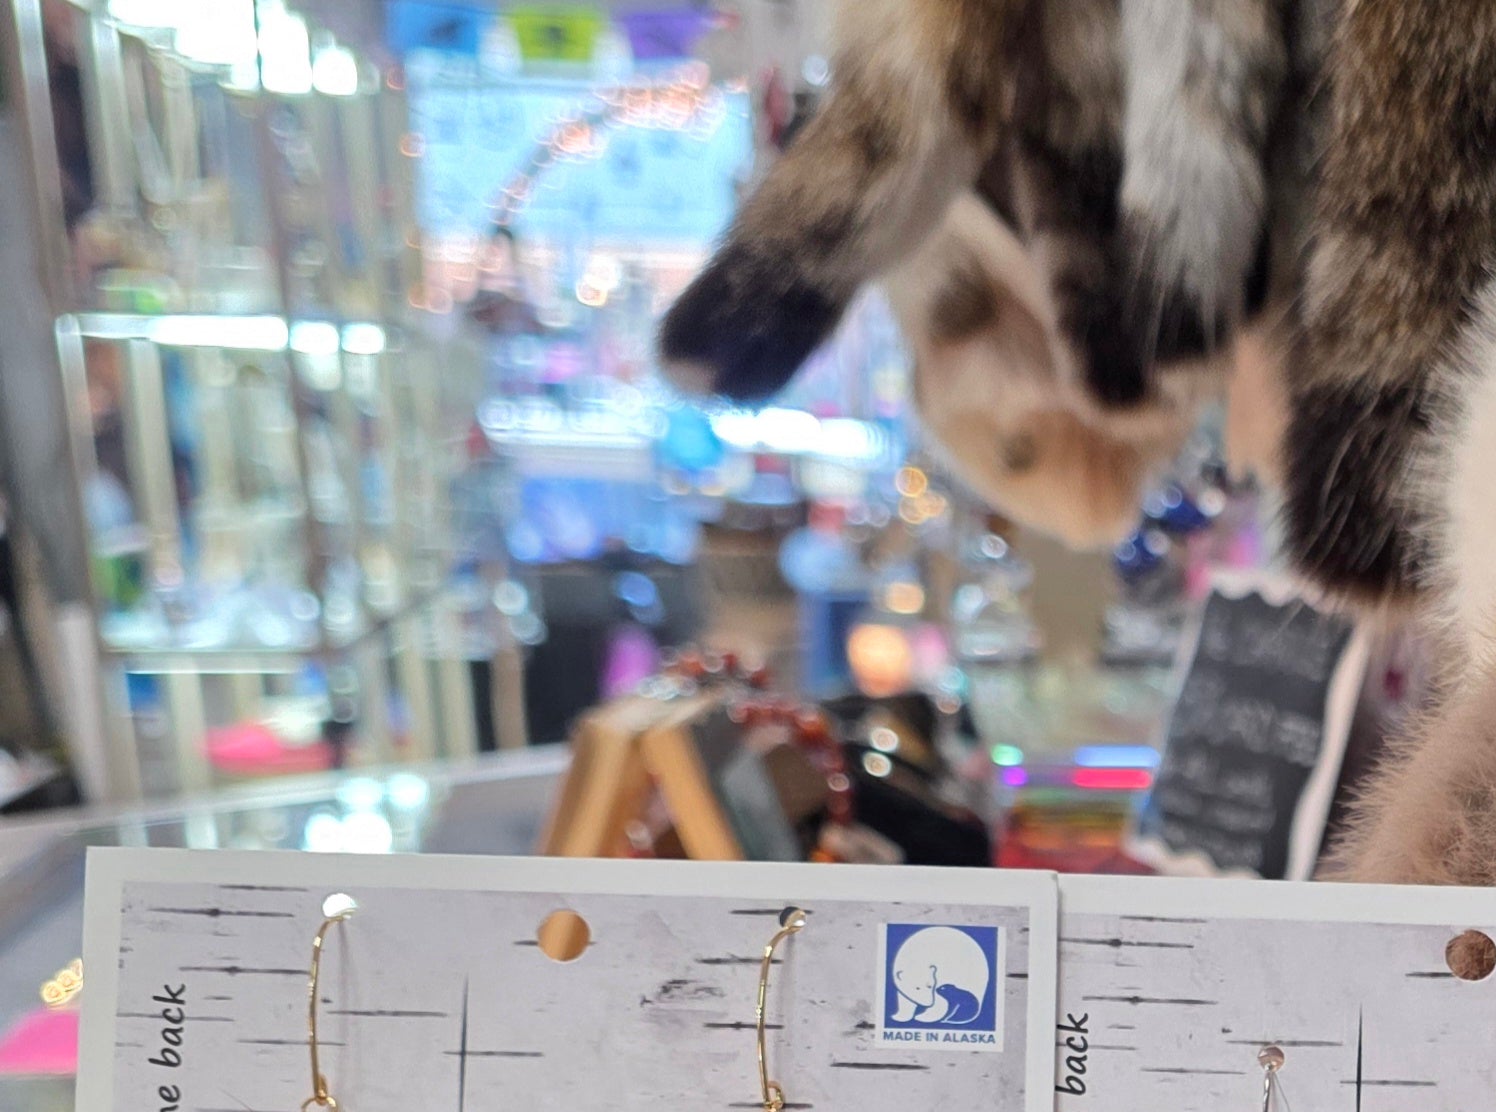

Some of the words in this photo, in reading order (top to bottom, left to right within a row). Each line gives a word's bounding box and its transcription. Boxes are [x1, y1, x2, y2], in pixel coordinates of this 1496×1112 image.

[148, 983, 187, 1069] back
[883, 1031, 921, 1041] MADE
[926, 1032, 939, 1042] IN
[942, 1033, 996, 1044] ALASKA
[1055, 1012, 1088, 1094] back
